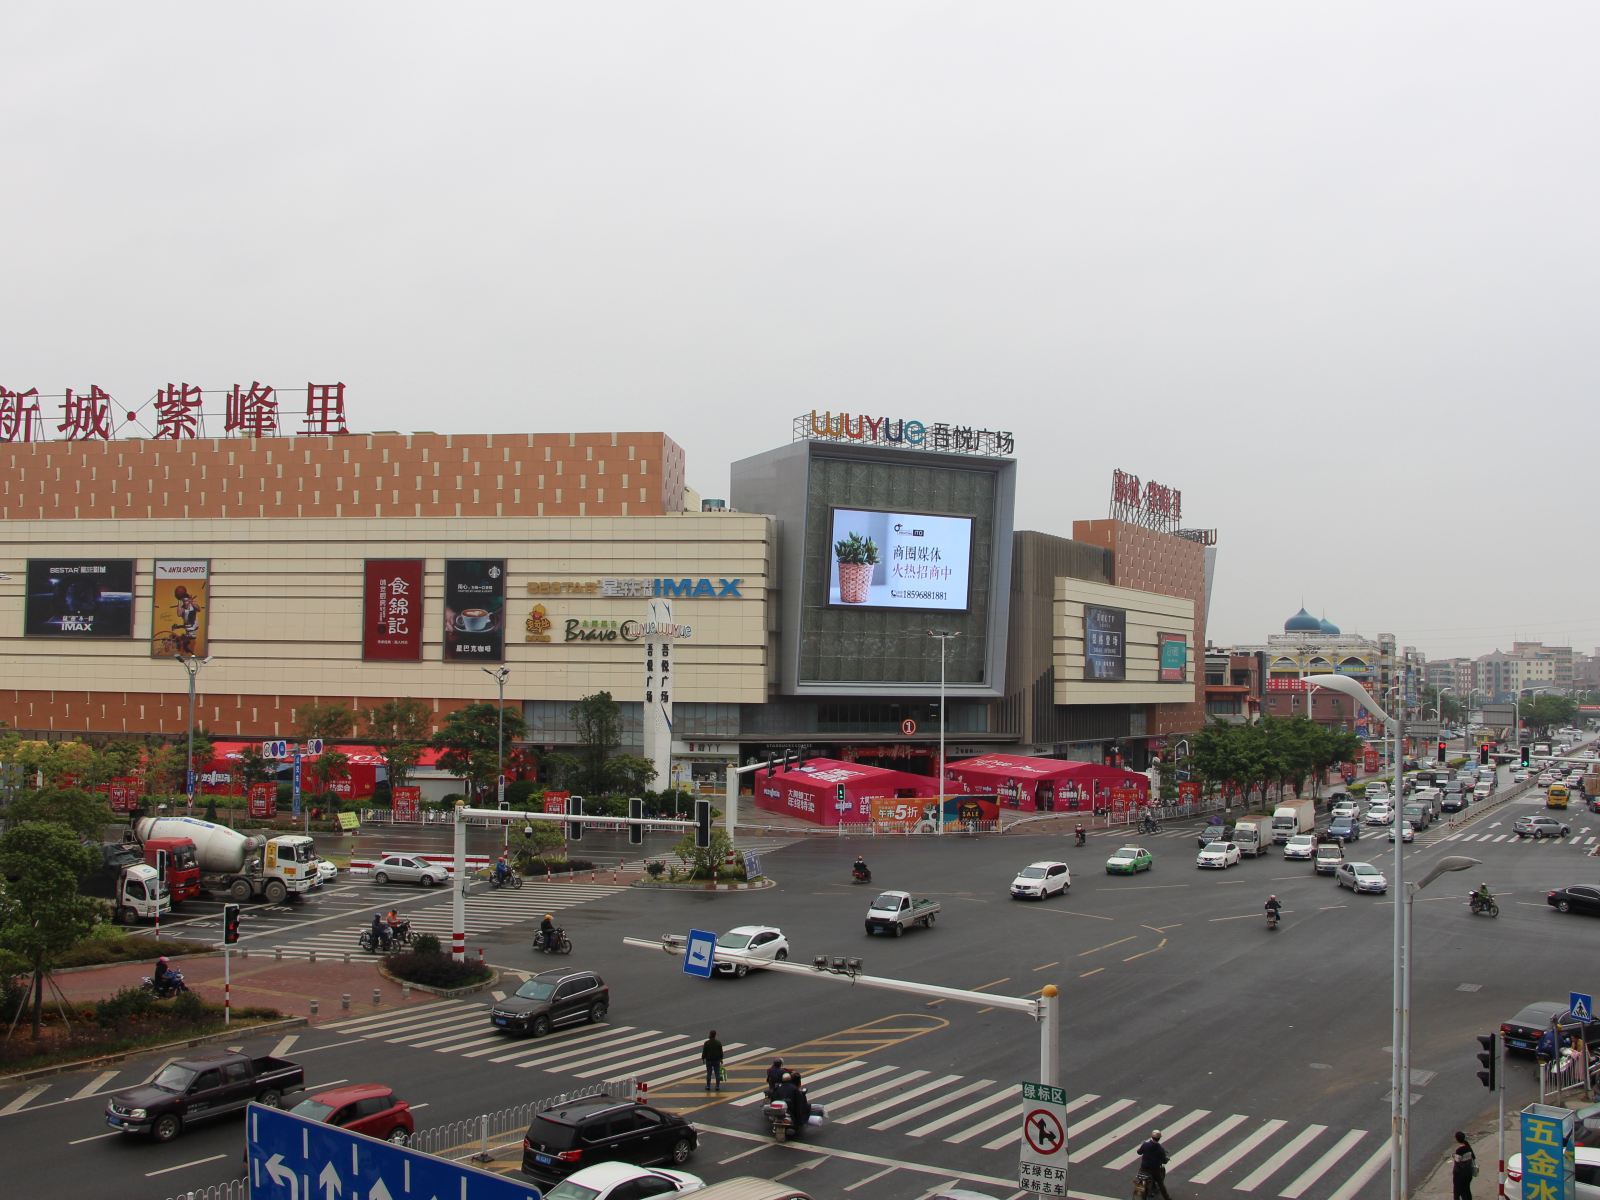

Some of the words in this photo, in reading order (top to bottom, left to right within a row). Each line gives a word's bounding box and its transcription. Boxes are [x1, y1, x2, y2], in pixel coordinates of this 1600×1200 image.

[932, 422, 1015, 454] 吾悦广场
[893, 545, 942, 562] 商圈媒体
[892, 563, 952, 581] 火热招商中
[654, 578, 742, 598] IMAX
[564, 619, 618, 642] Bravo
[661, 643, 669, 702] 吾悦广场
[1024, 1084, 1064, 1103] 绿标区
[1021, 1164, 1065, 1181] 无绿色环
[1021, 1178, 1064, 1195] 保标志车
